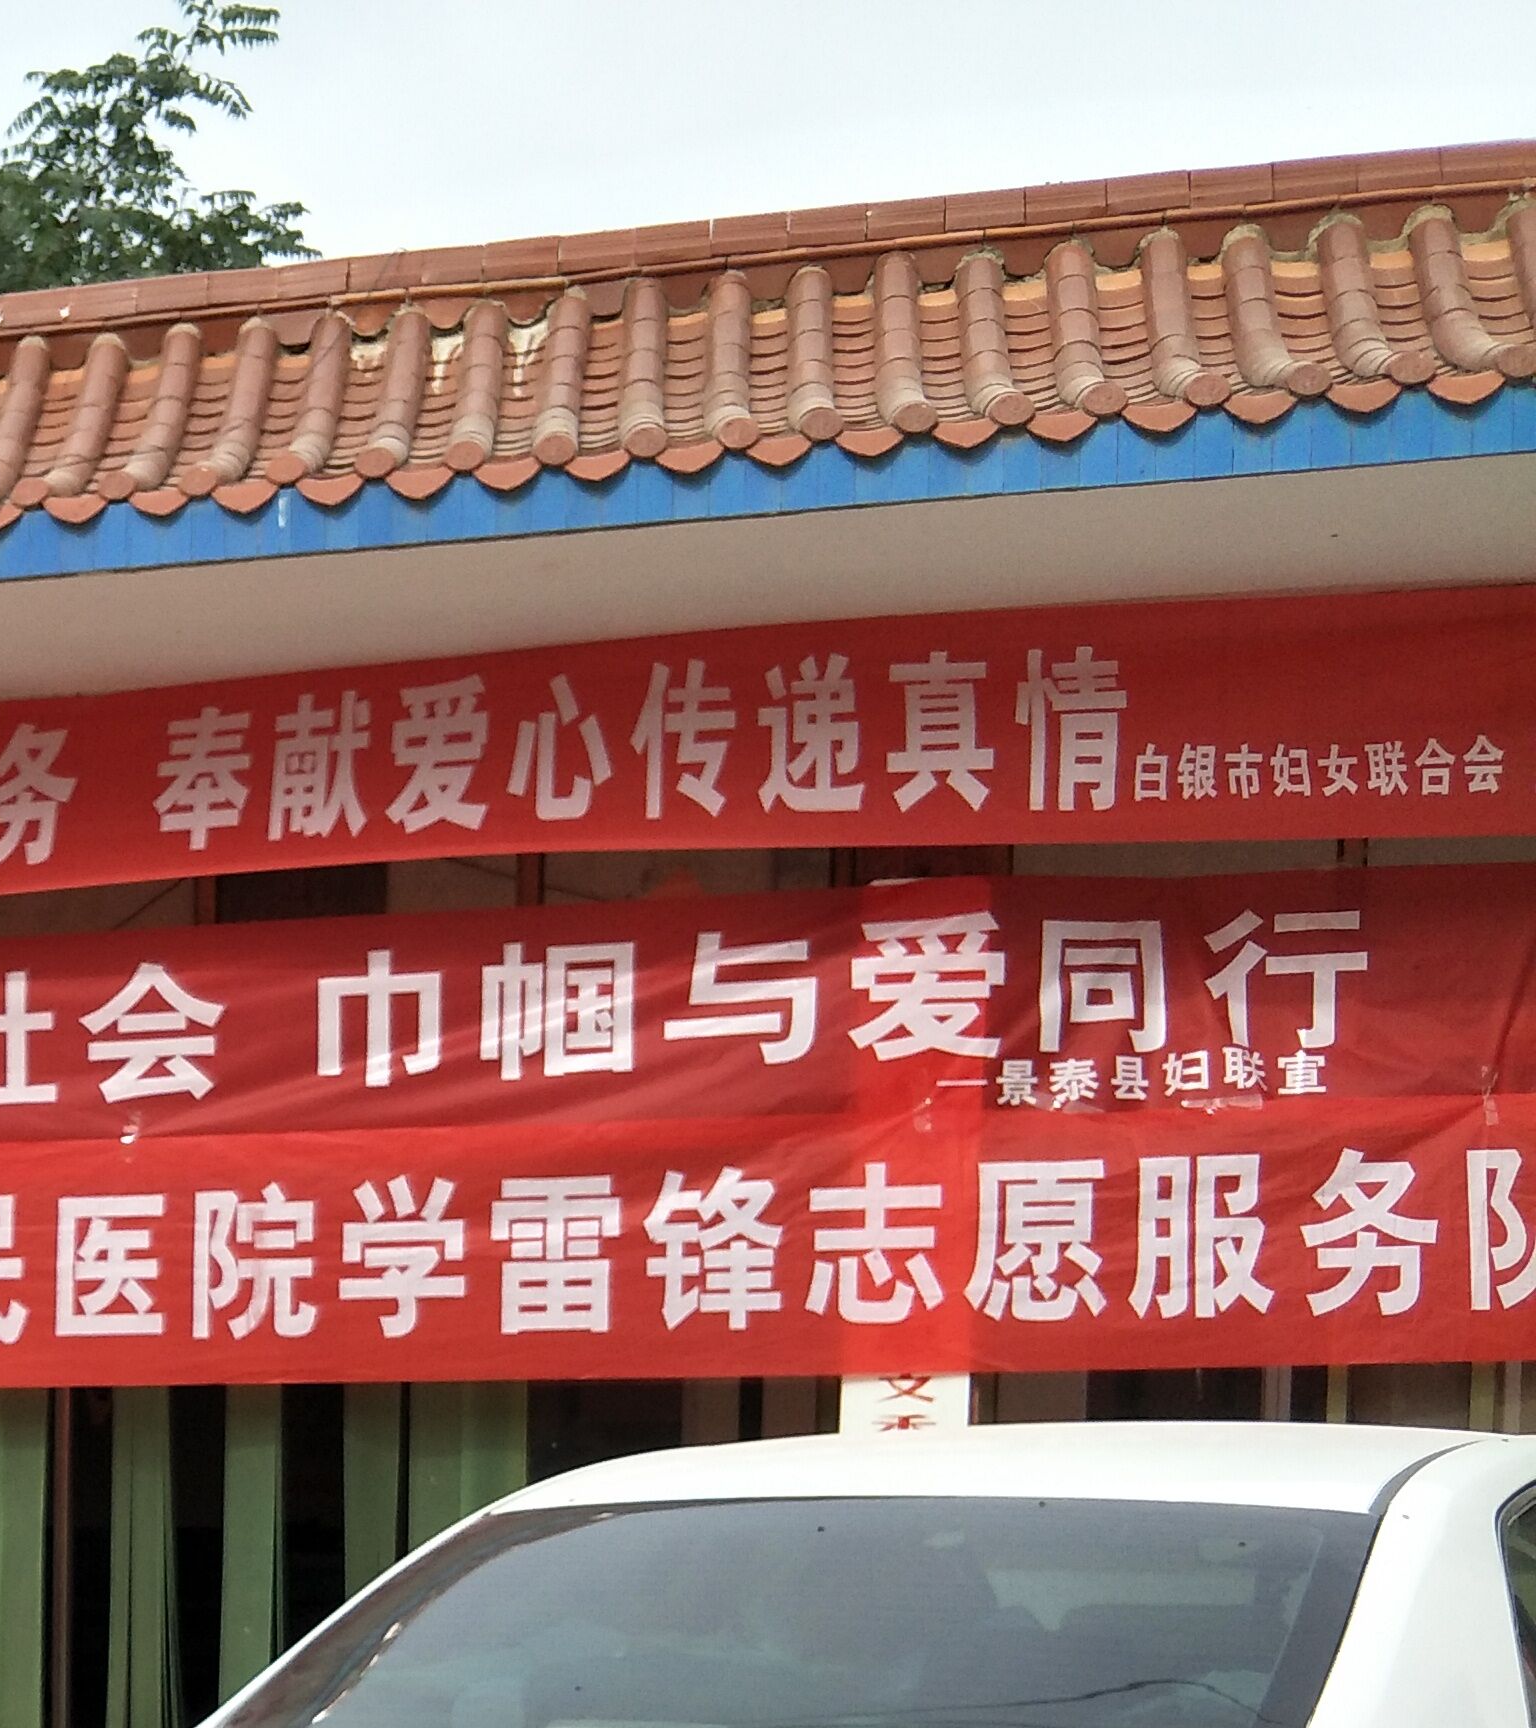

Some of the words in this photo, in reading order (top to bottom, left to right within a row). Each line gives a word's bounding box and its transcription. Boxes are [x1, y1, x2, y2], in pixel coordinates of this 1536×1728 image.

[155, 647, 1128, 850] 奉献爱心传递真情
[1135, 734, 1504, 801] 白银市妇女联合会
[317, 911, 1368, 1087] 巾帼与爱同行
